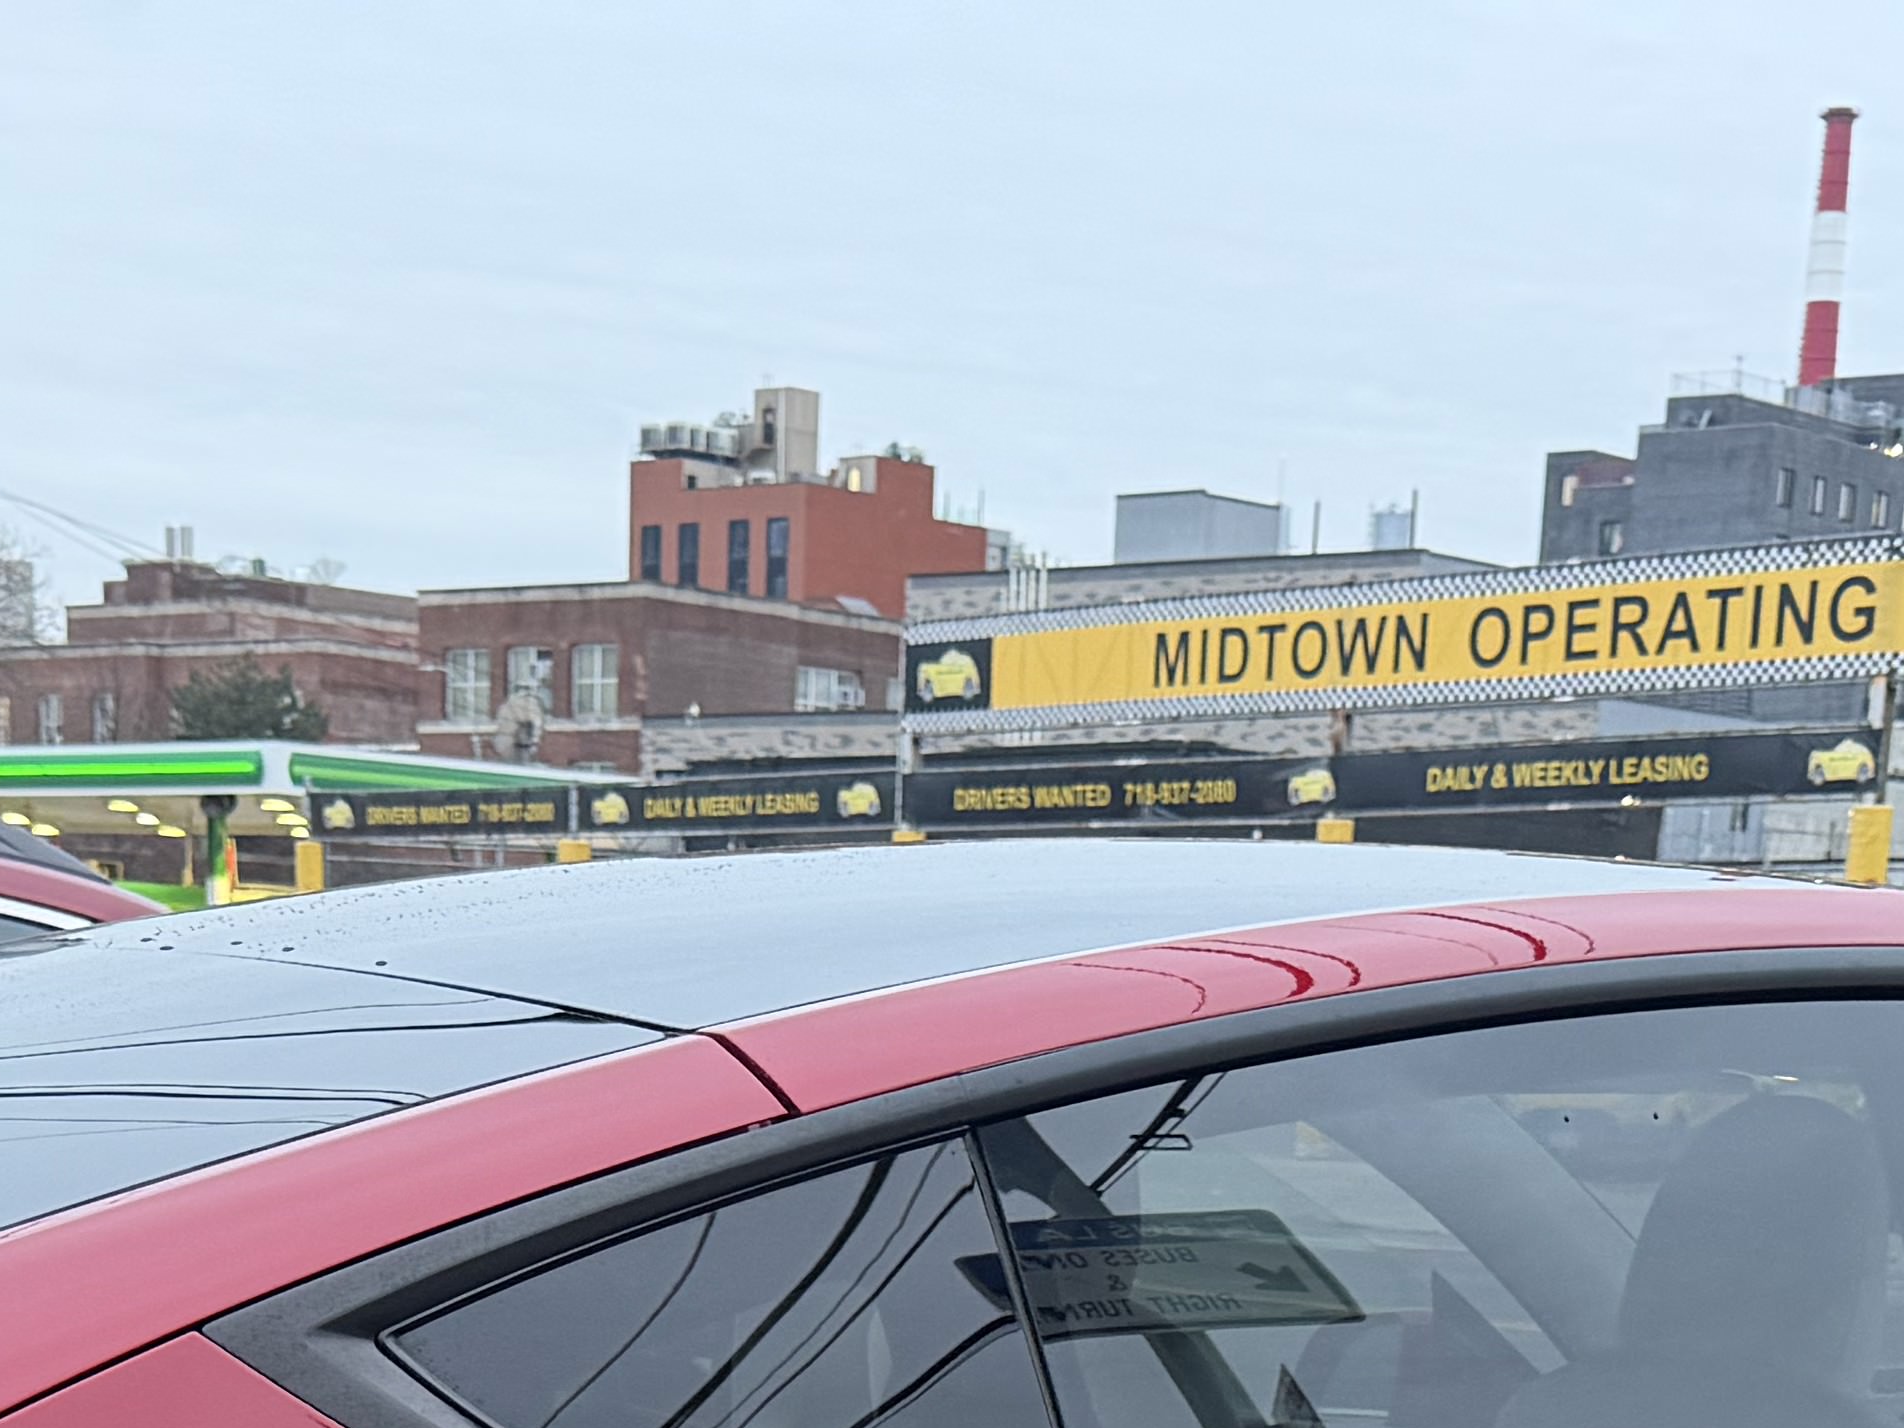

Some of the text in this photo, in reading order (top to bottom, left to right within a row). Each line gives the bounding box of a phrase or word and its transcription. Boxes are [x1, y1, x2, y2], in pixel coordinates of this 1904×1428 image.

[1153, 612, 1431, 689] MIDTOWN
[1468, 575, 1879, 669] OPERATING
[1425, 753, 1711, 792] DAILY & WEEKLY LEASING
[953, 785, 1031, 811] DRIVERS
[1032, 783, 1112, 809] WANTED
